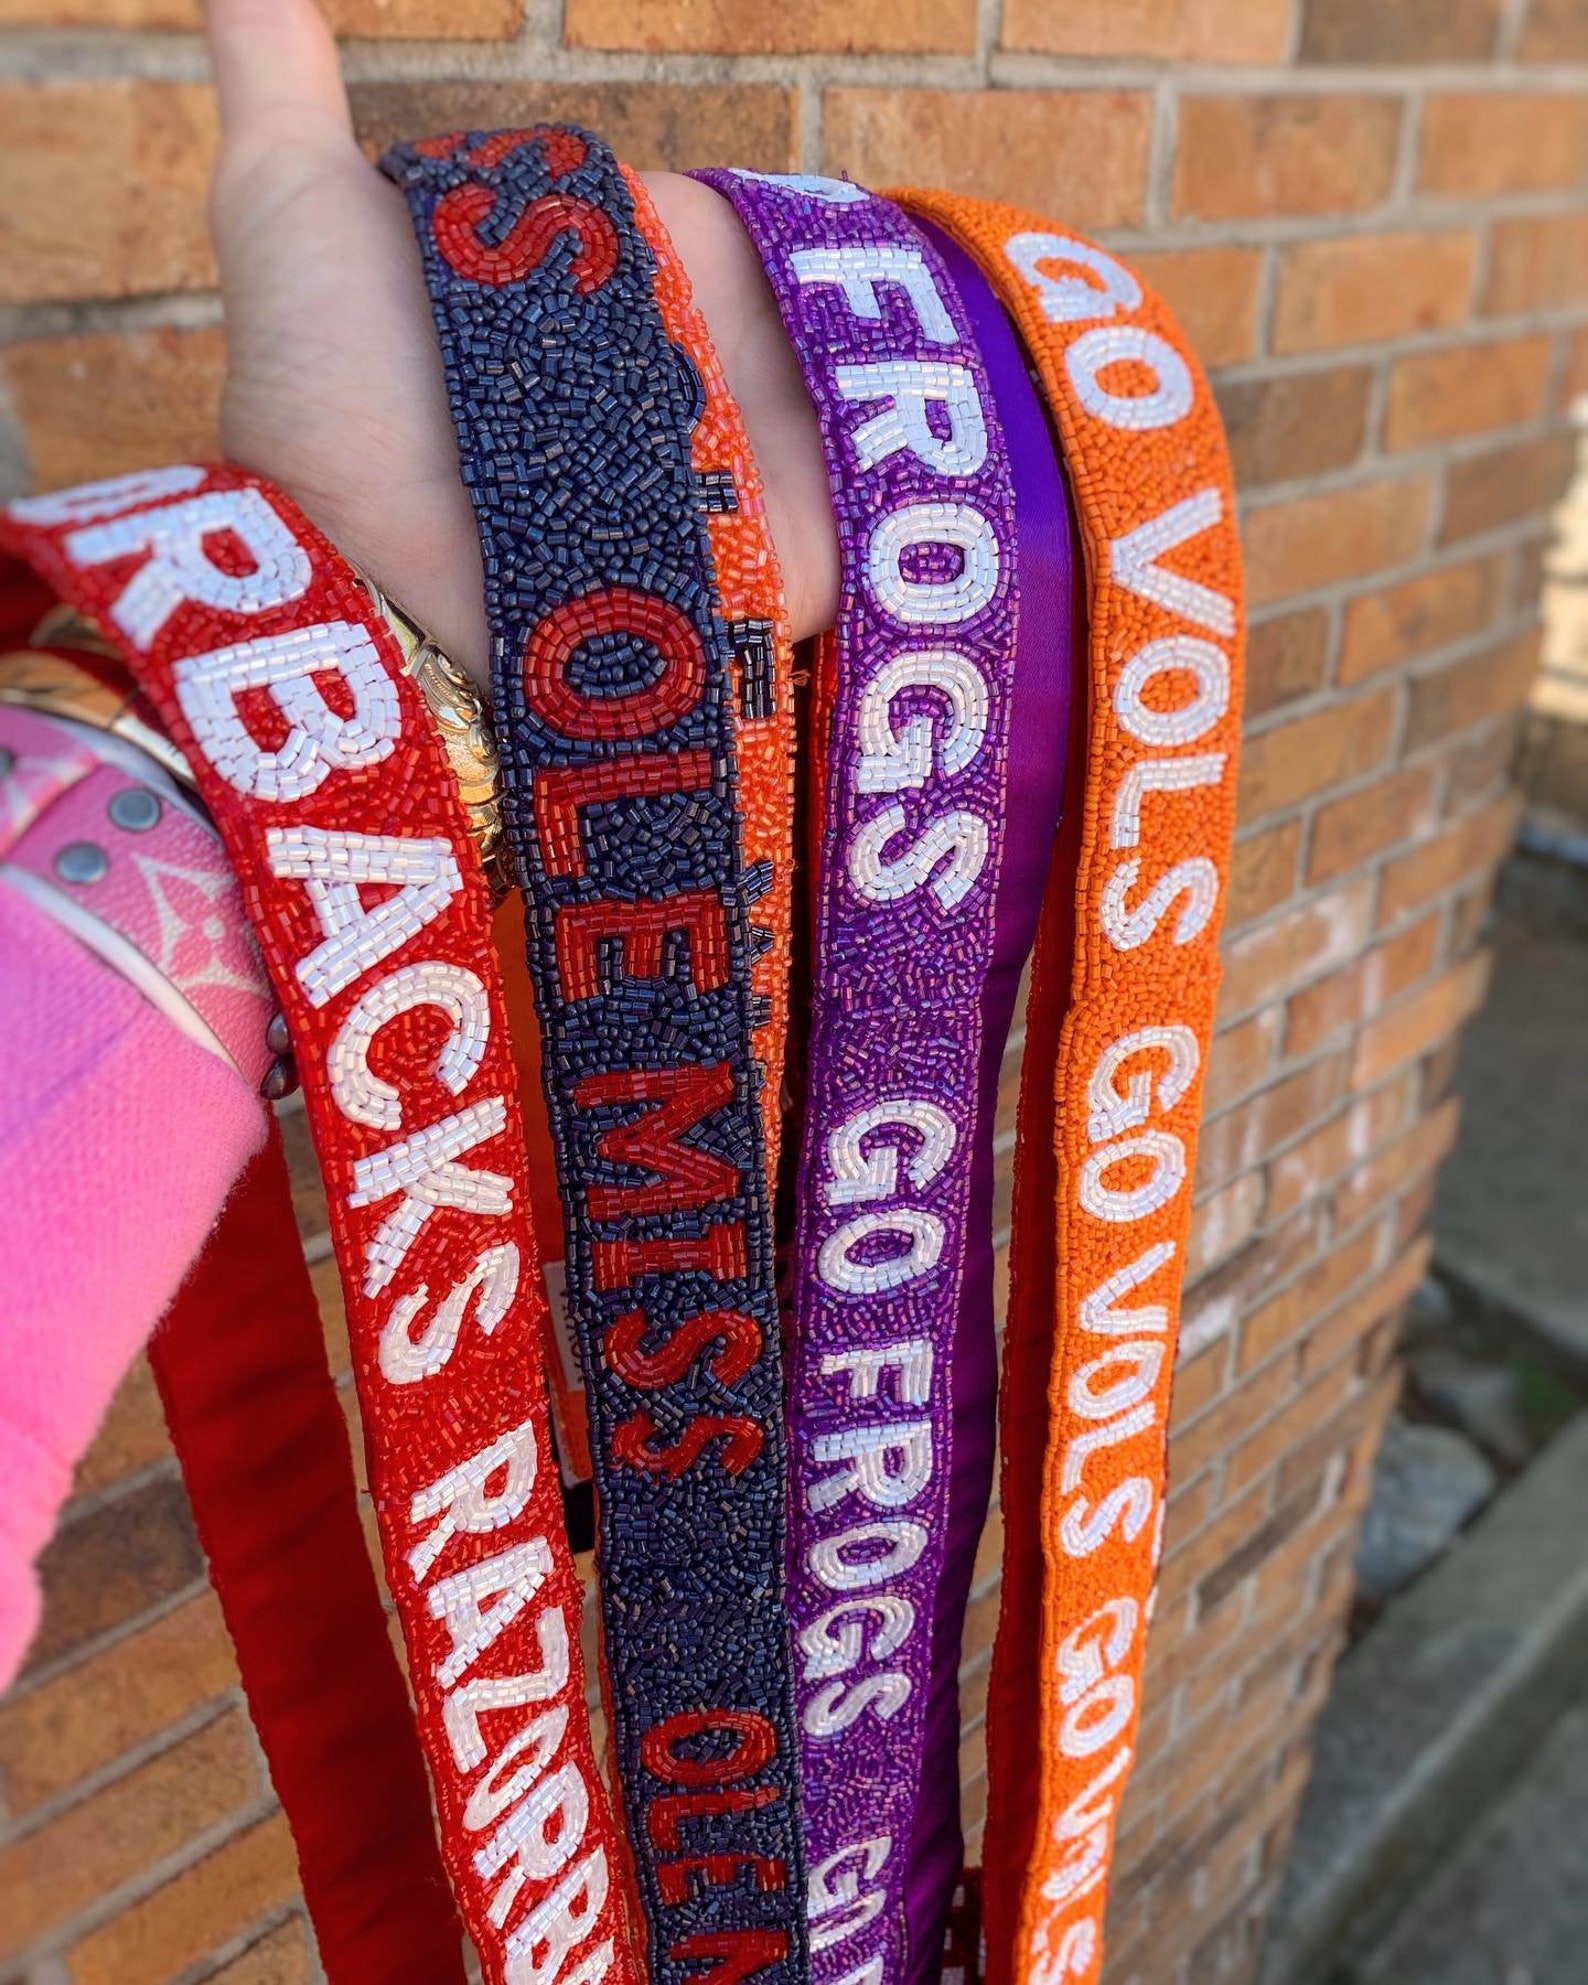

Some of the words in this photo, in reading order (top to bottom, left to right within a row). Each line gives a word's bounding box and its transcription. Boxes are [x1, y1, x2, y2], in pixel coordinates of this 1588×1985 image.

[1003, 232, 1194, 430] GO
[788, 246, 1000, 912] FROGS
[1102, 488, 1236, 950] VOLS
[522, 587, 731, 1002] OLE
[574, 1061, 766, 1484] MISS
[816, 1100, 956, 1294] GO
[1078, 1024, 1200, 1222] GO
[800, 1340, 934, 1737] FROGS
[1060, 1240, 1178, 1557] VOLS
[641, 1708, 787, 1906] OLE
[1057, 1597, 1138, 1757] GO
